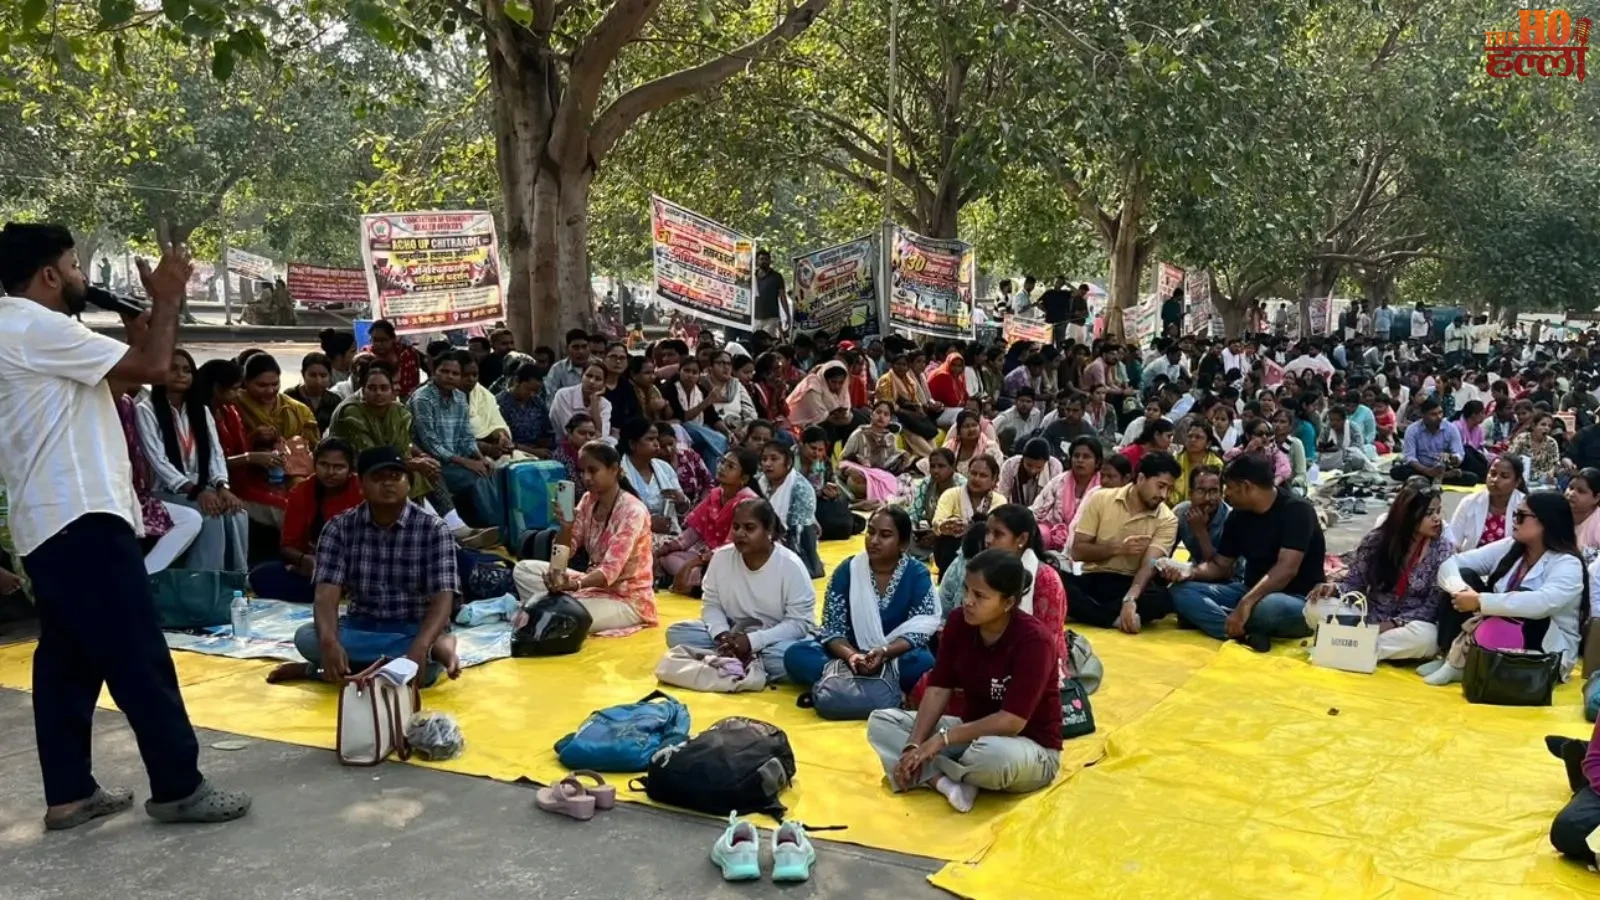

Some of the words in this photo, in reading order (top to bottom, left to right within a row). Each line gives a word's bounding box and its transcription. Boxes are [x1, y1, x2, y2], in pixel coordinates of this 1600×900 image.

[413, 223, 436, 231] HEALTH
[392, 239, 417, 250] ACHO
[419, 239, 430, 249] UP
[905, 253, 927, 272] 30
